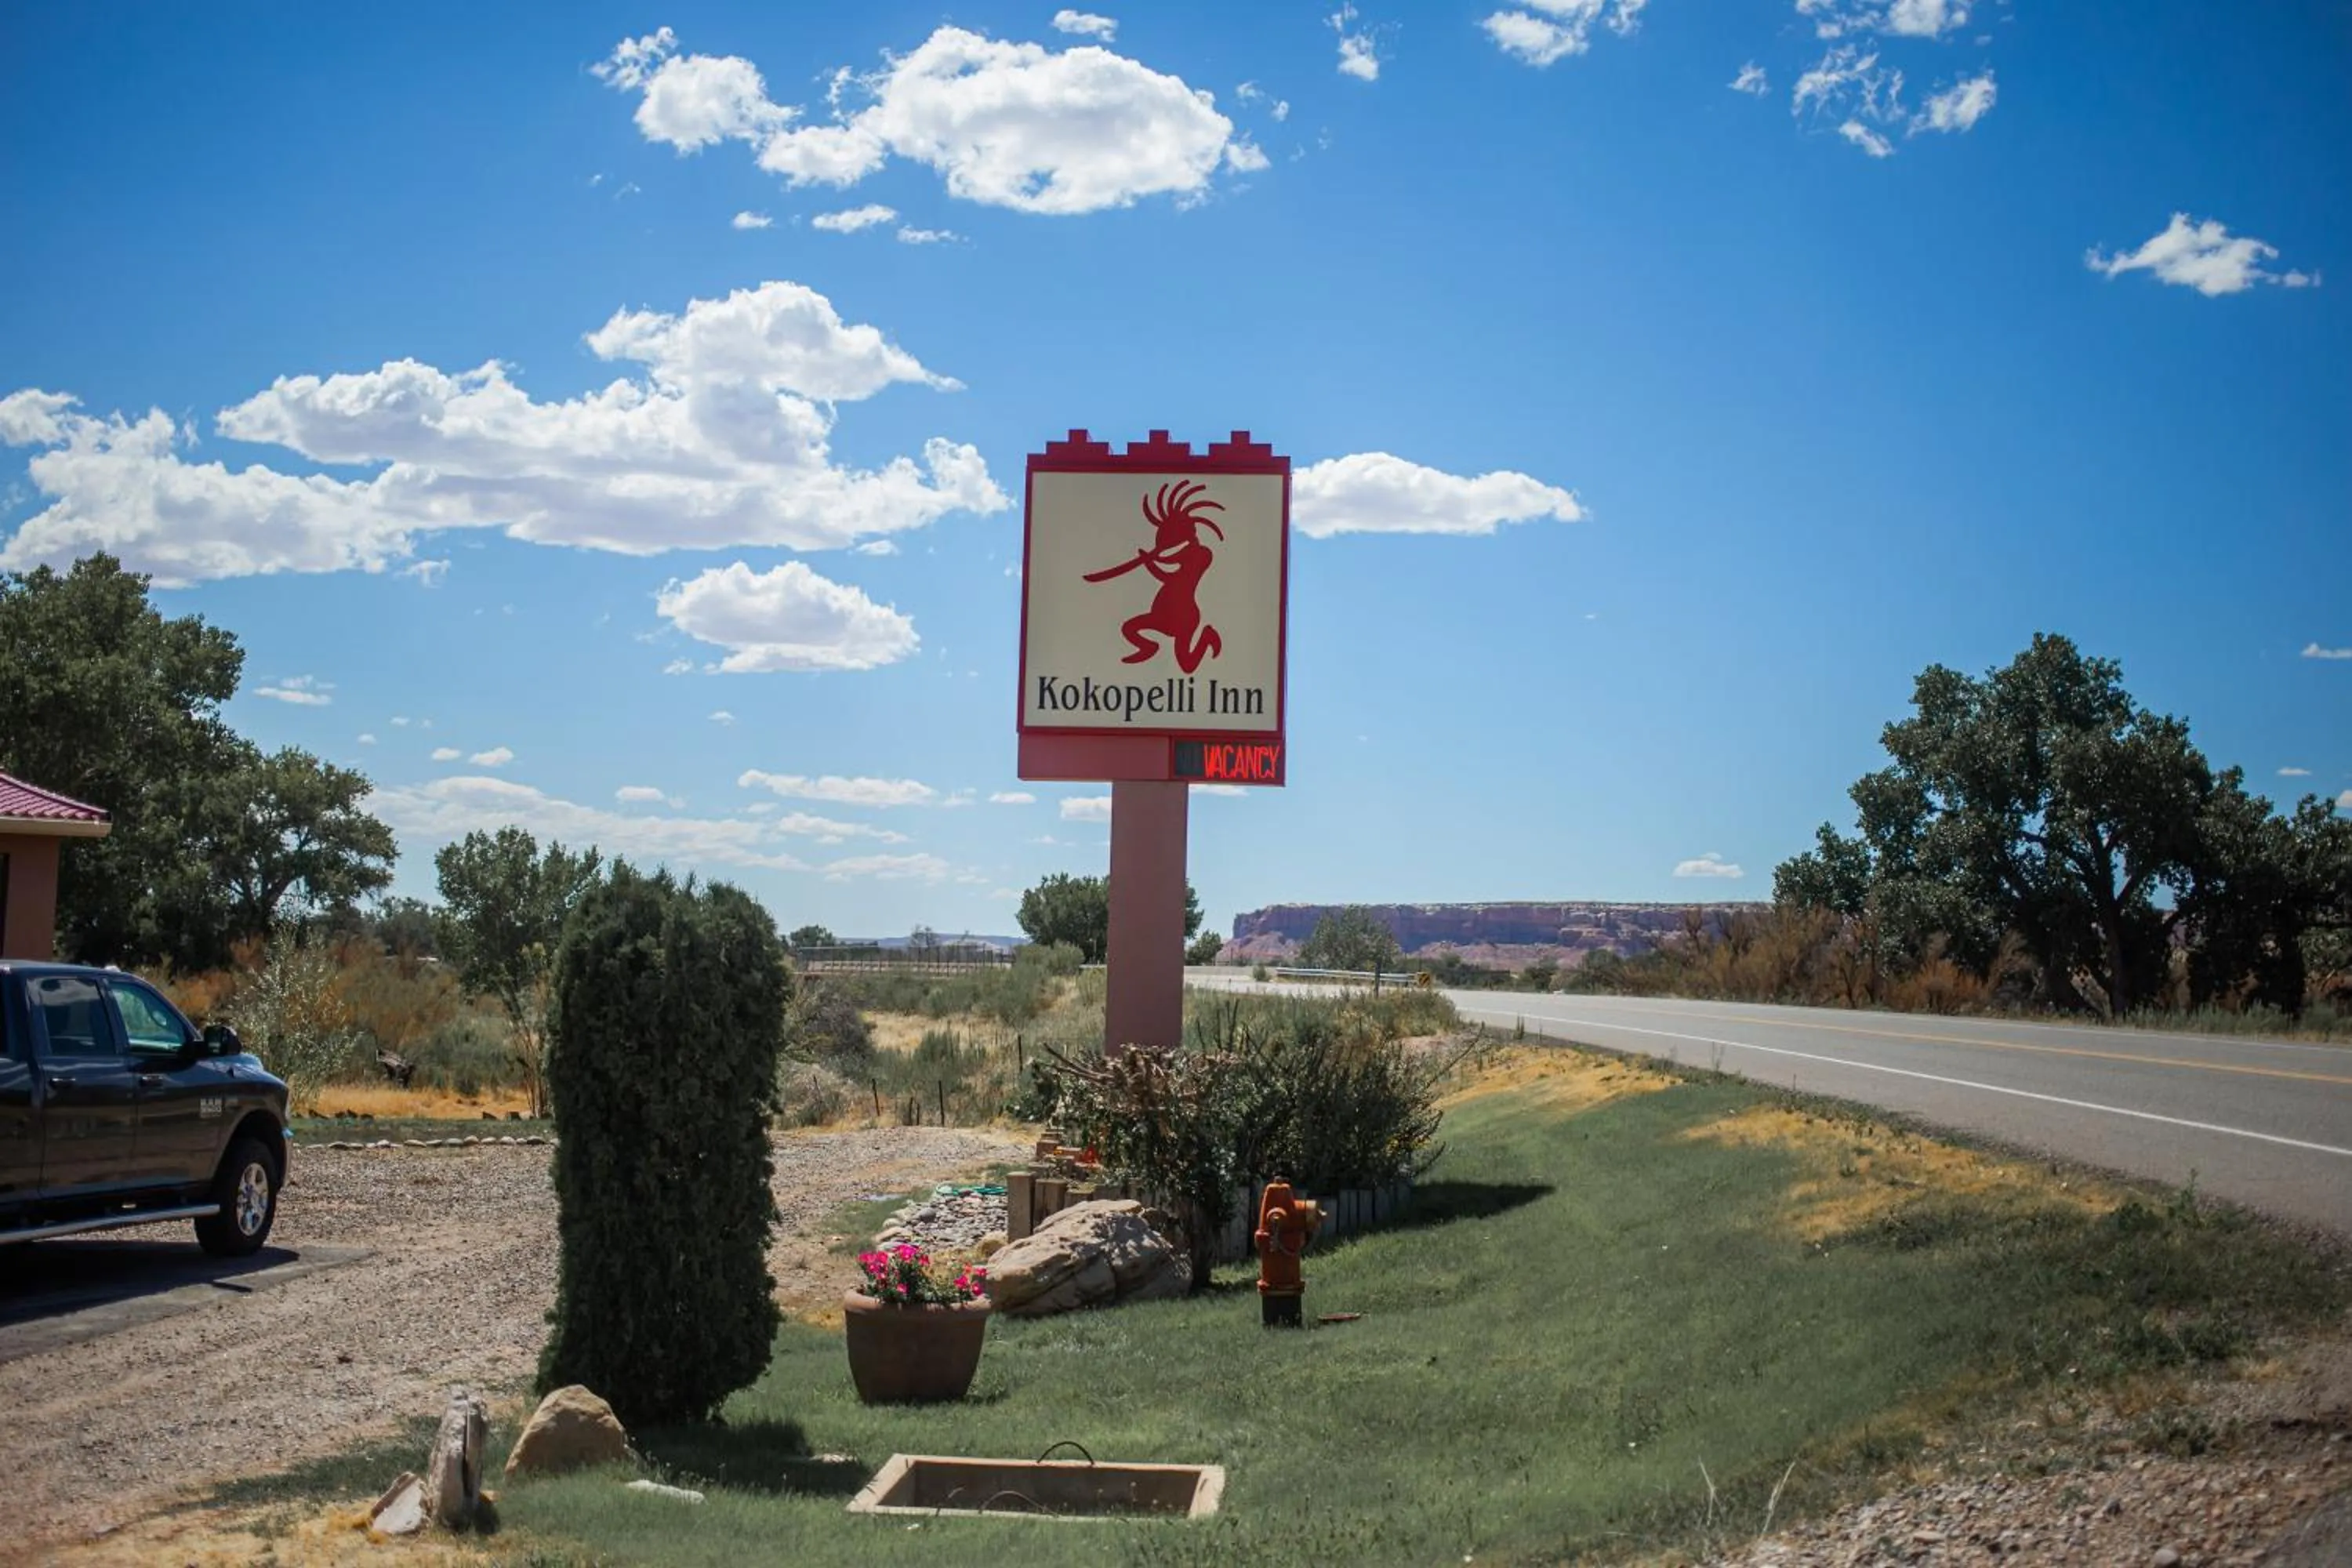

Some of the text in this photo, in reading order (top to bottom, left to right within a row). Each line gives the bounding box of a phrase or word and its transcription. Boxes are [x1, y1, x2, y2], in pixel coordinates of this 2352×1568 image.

[1037, 676, 1264, 722] Kokopelli Inn
[1203, 744, 1280, 779] VACANCY
